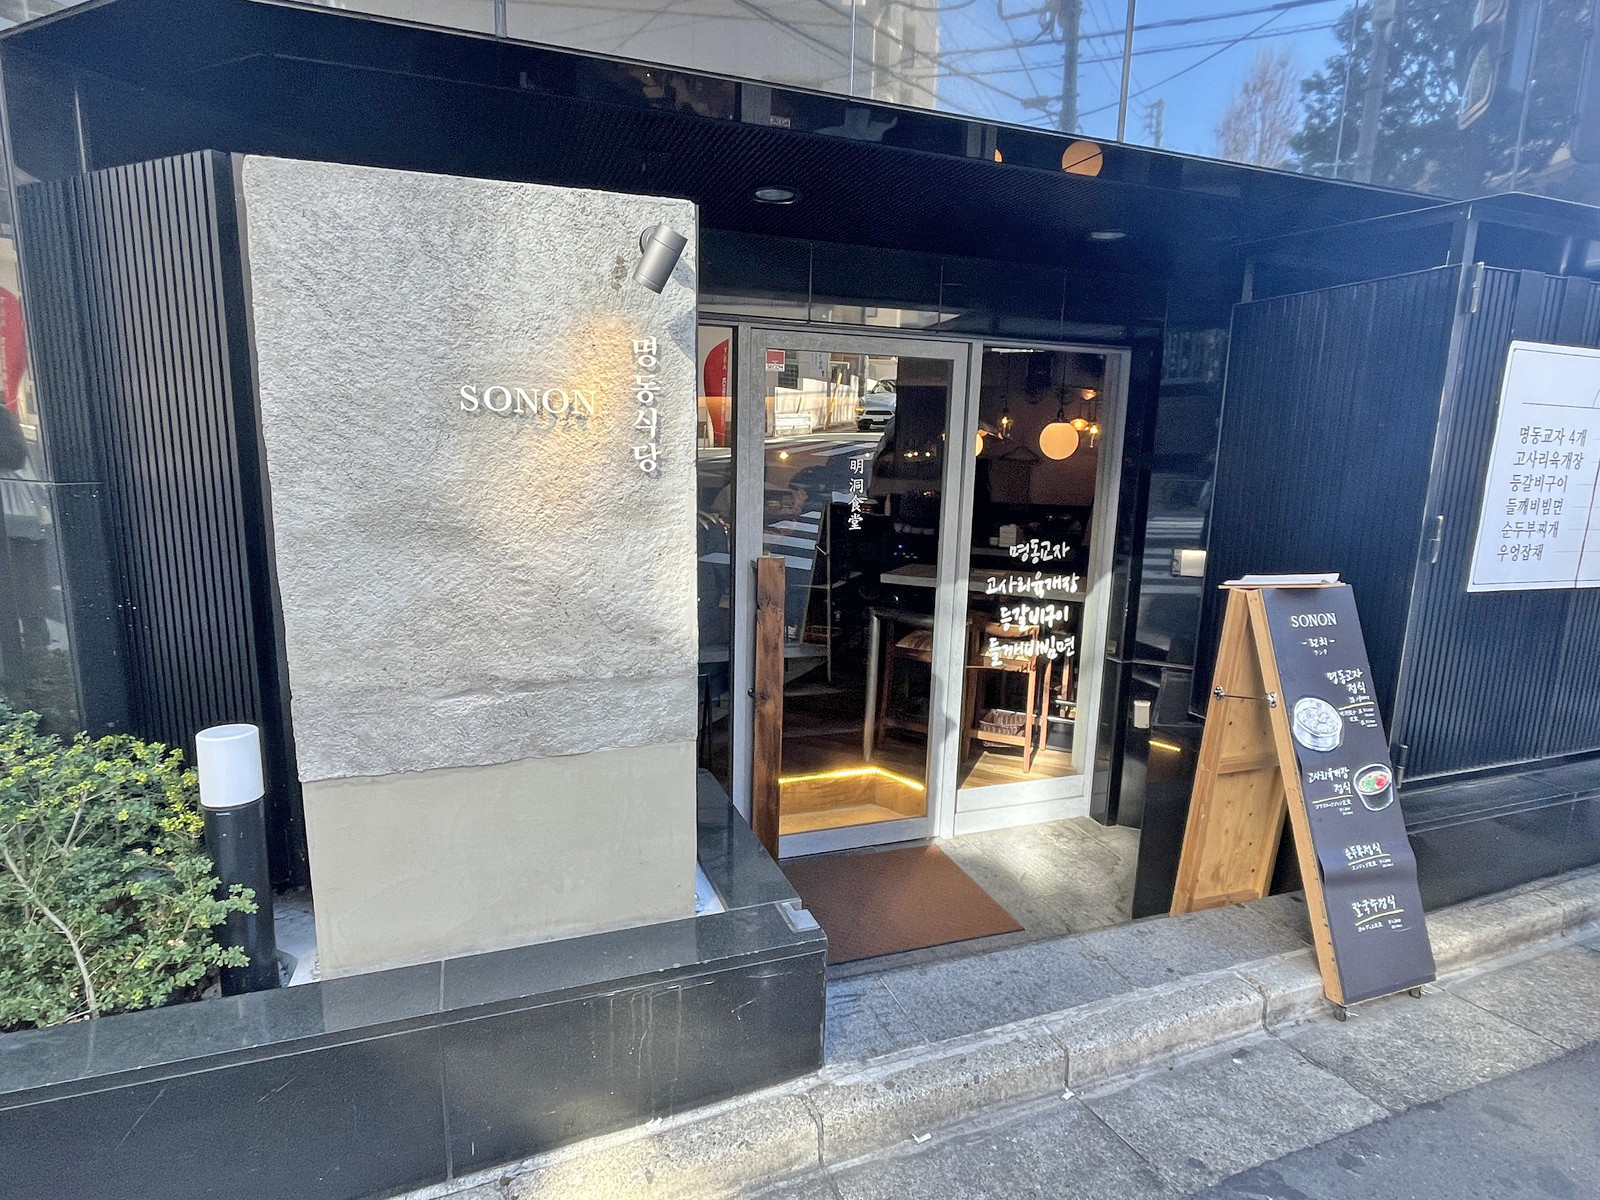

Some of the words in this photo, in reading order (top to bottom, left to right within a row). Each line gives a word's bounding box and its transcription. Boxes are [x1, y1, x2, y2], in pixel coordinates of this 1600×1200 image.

[460, 384, 597, 415] SONON
[630, 336, 661, 472] 명동식당
[1520, 425, 1565, 446] 명동교자
[1513, 450, 1584, 470] 고사리육개장
[848, 459, 866, 531] 明洞食堂
[1510, 474, 1569, 493] 등갈비구이
[1506, 497, 1564, 516] 들깨비빔면
[1501, 521, 1559, 539] 순두부찌개
[1009, 538, 1070, 564] 명동교자
[1497, 544, 1544, 562] 우엉잡채
[985, 571, 1080, 599] 고사리육개장
[1000, 604, 1069, 632] 등갈비구이
[1291, 613, 1337, 628] SONON
[988, 635, 1075, 667] 들깨비빔면
